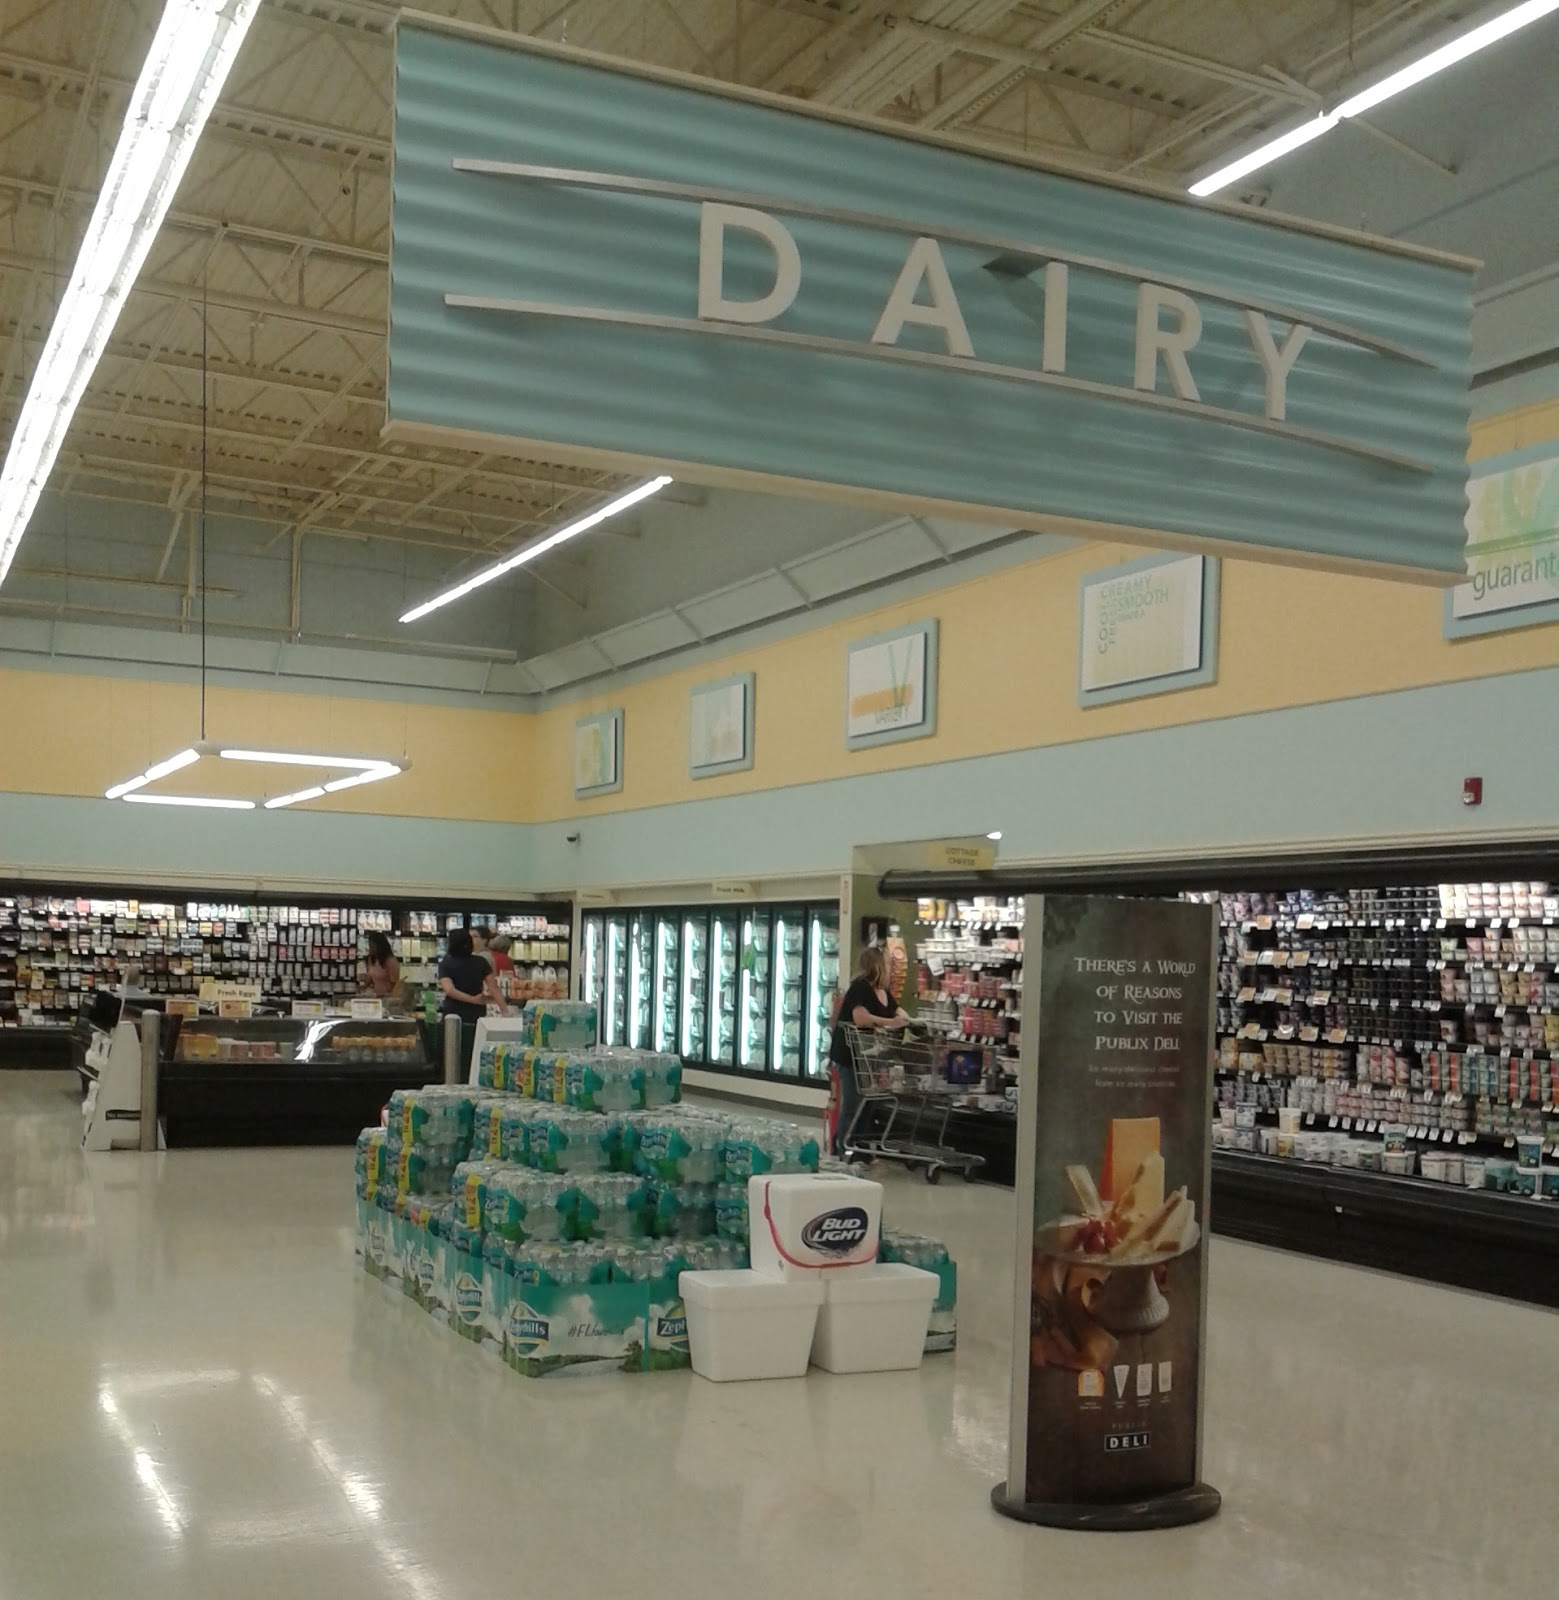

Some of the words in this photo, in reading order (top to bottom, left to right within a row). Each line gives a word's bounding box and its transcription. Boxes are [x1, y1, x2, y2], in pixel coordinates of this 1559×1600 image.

[697, 201, 1313, 421] DAIRY
[1074, 957, 1136, 975] THERE'S
[1142, 961, 1151, 972] A
[1157, 960, 1196, 977] WORLD
[239, 990, 256, 998] Eggs
[1096, 985, 1118, 999] OF
[1124, 984, 1182, 1004] REASONS
[1094, 1011, 1116, 1024] TO
[1122, 1010, 1157, 1025] VISIT
[1162, 1012, 1183, 1025] THE
[1095, 1036, 1149, 1050] PUBLIX
[1154, 1036, 1180, 1050] DELI
[822, 1217, 862, 1230] BUD
[812, 1227, 866, 1243] LIGHT
[1109, 1434, 1148, 1449] DELI
